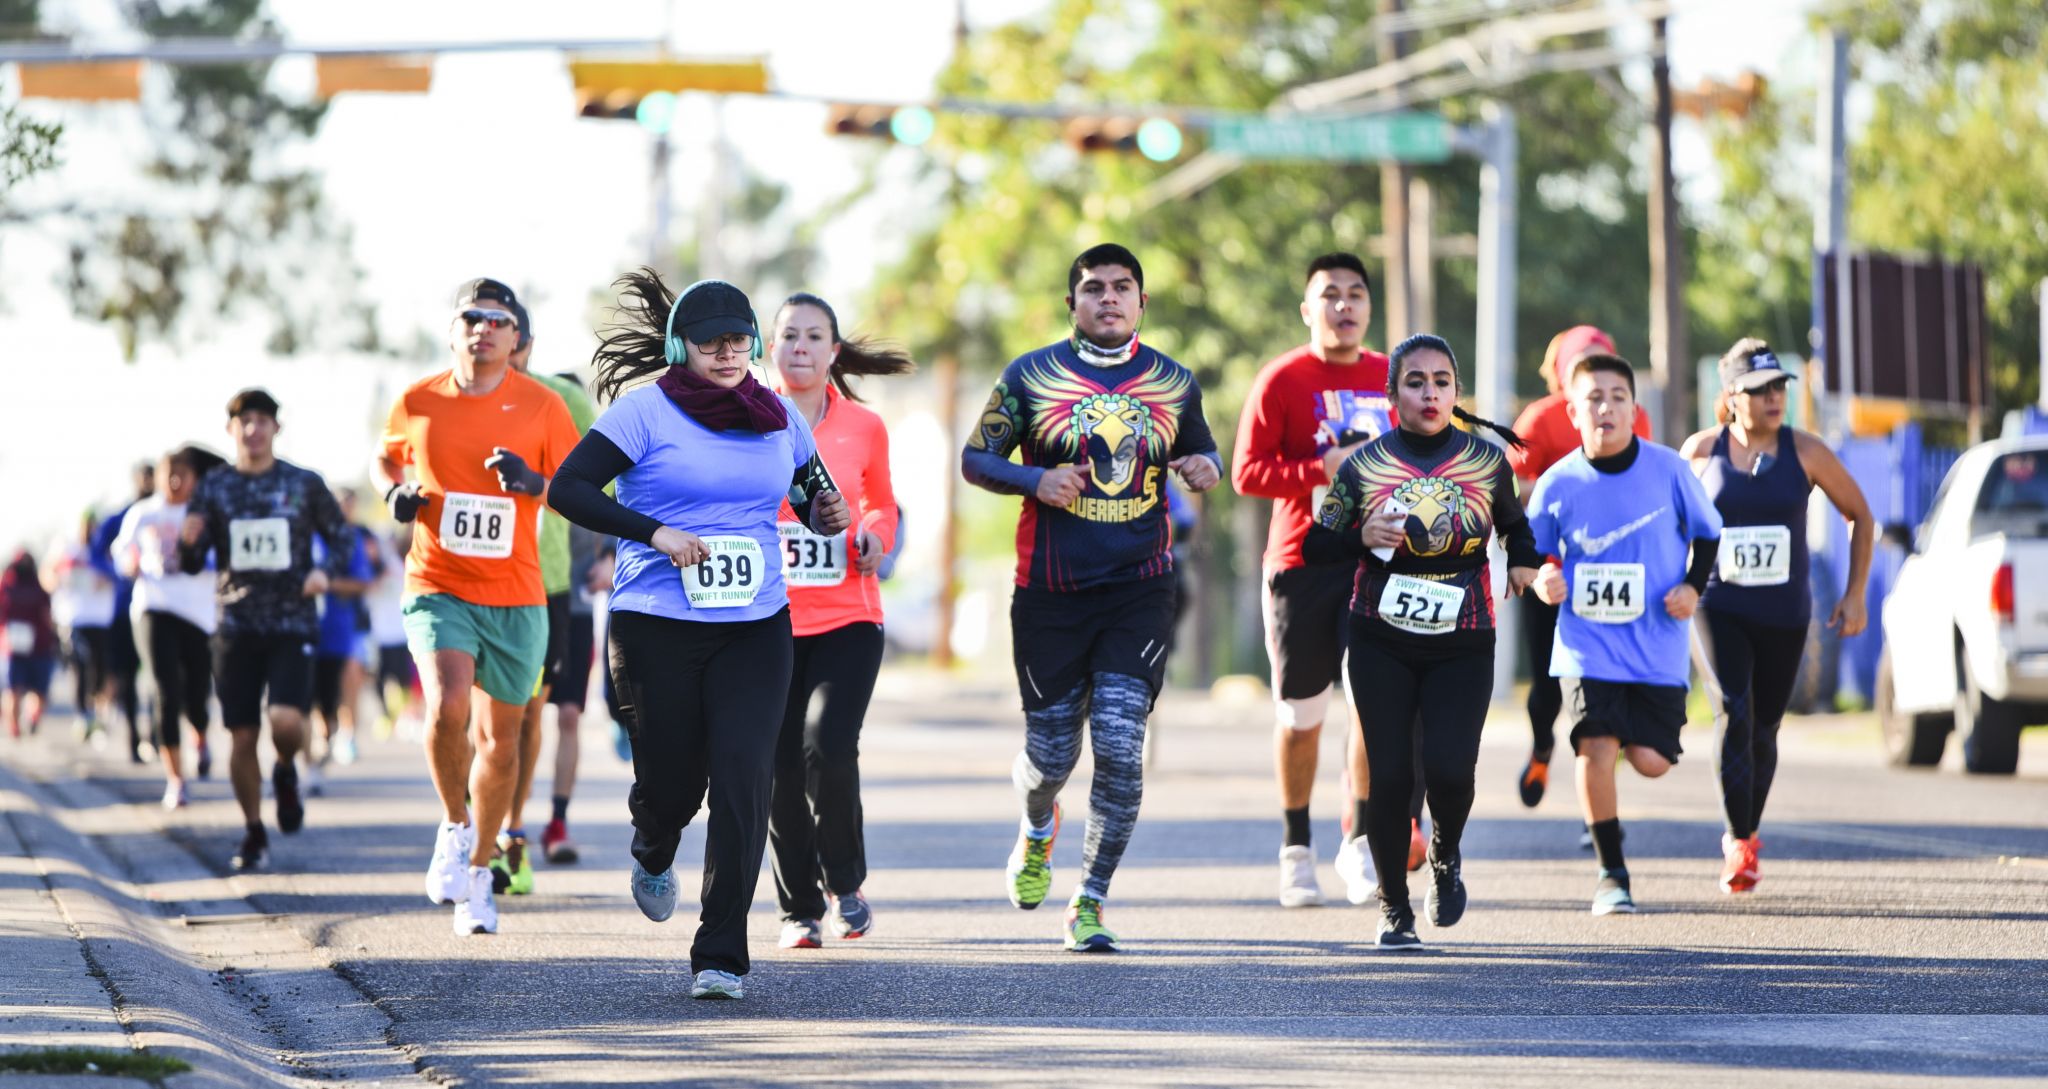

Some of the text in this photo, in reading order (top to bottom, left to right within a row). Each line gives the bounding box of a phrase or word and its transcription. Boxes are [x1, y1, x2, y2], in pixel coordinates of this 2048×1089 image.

[455, 510, 501, 540] 618
[723, 541, 756, 551] TIMING
[786, 539, 834, 568] 531
[1734, 543, 1777, 568] 637
[697, 554, 752, 588] 639
[690, 591, 718, 602] SWIFT
[1395, 579, 1457, 600] SWIFT TIMING
[1587, 581, 1630, 607] 544
[1394, 592, 1443, 623] 521
